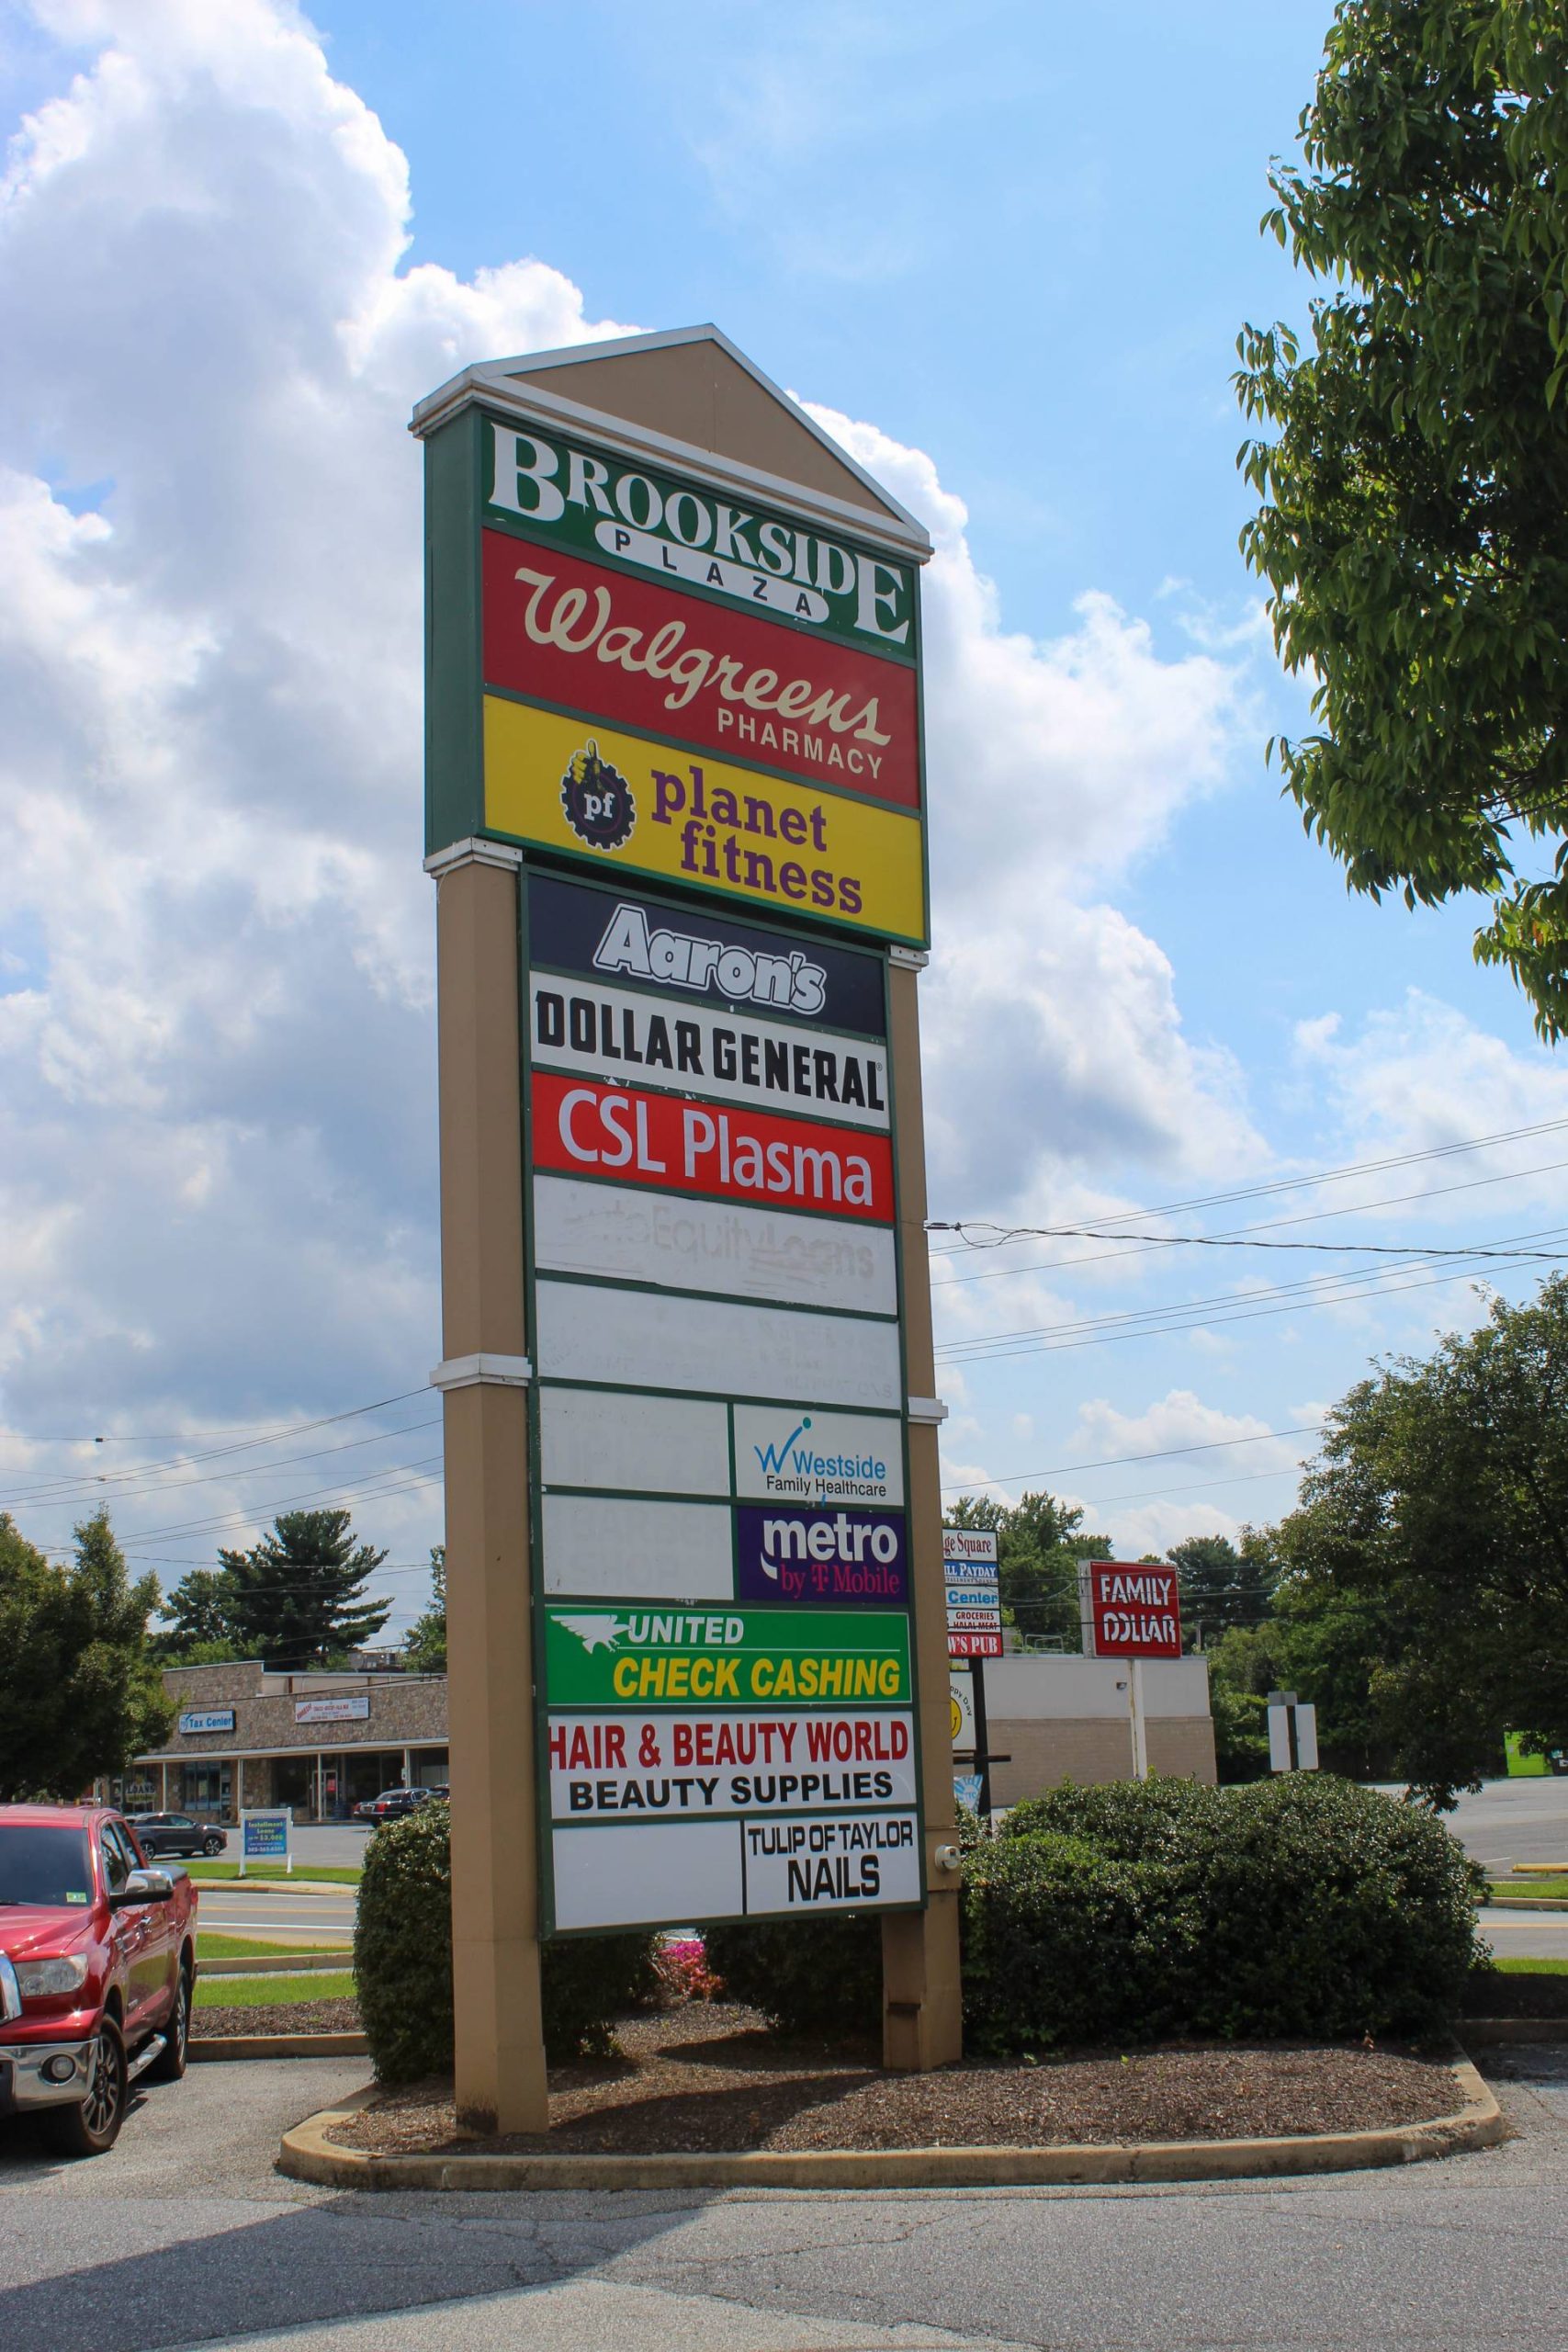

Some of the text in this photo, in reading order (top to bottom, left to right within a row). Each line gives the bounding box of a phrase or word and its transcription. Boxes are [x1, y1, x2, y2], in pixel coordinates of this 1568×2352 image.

[489, 423, 909, 644] BROOKSIDE
[615, 529, 812, 616] PLAZA
[515, 567, 890, 745] Walgreens
[717, 707, 882, 779] PHARMACY
[584, 792, 615, 821] pf
[650, 765, 827, 852] planet
[681, 820, 863, 914] fitness
[593, 903, 827, 1014] Aaron's
[536, 990, 704, 1076] DOLLAR
[558, 1090, 873, 1206] CSL Plasma
[793, 1450, 886, 1479] Westside
[767, 1476, 886, 1497] Family Healthcare
[762, 1512, 898, 1564] metro
[957, 1532, 992, 1557] Square
[781, 1564, 806, 1599] by
[948, 1590, 998, 1605] Center
[1100, 1575, 1172, 1606] FAMILY
[628, 1615, 744, 1645] UNITED
[955, 1611, 995, 1621] GROCERIES
[1103, 1612, 1177, 1644] DOLLAR
[948, 1636, 998, 1654] W'S PUB
[614, 1657, 900, 1698] CHECK CASHING
[189, 1719, 203, 1728] Tax
[548, 1721, 908, 1770] HAIR & BEAUTY WORLD
[570, 1771, 893, 1811] BEAUTY SUPPLIES
[748, 1820, 914, 1856] TULIP OF TAYLOR
[787, 1854, 881, 1902] NAILS
